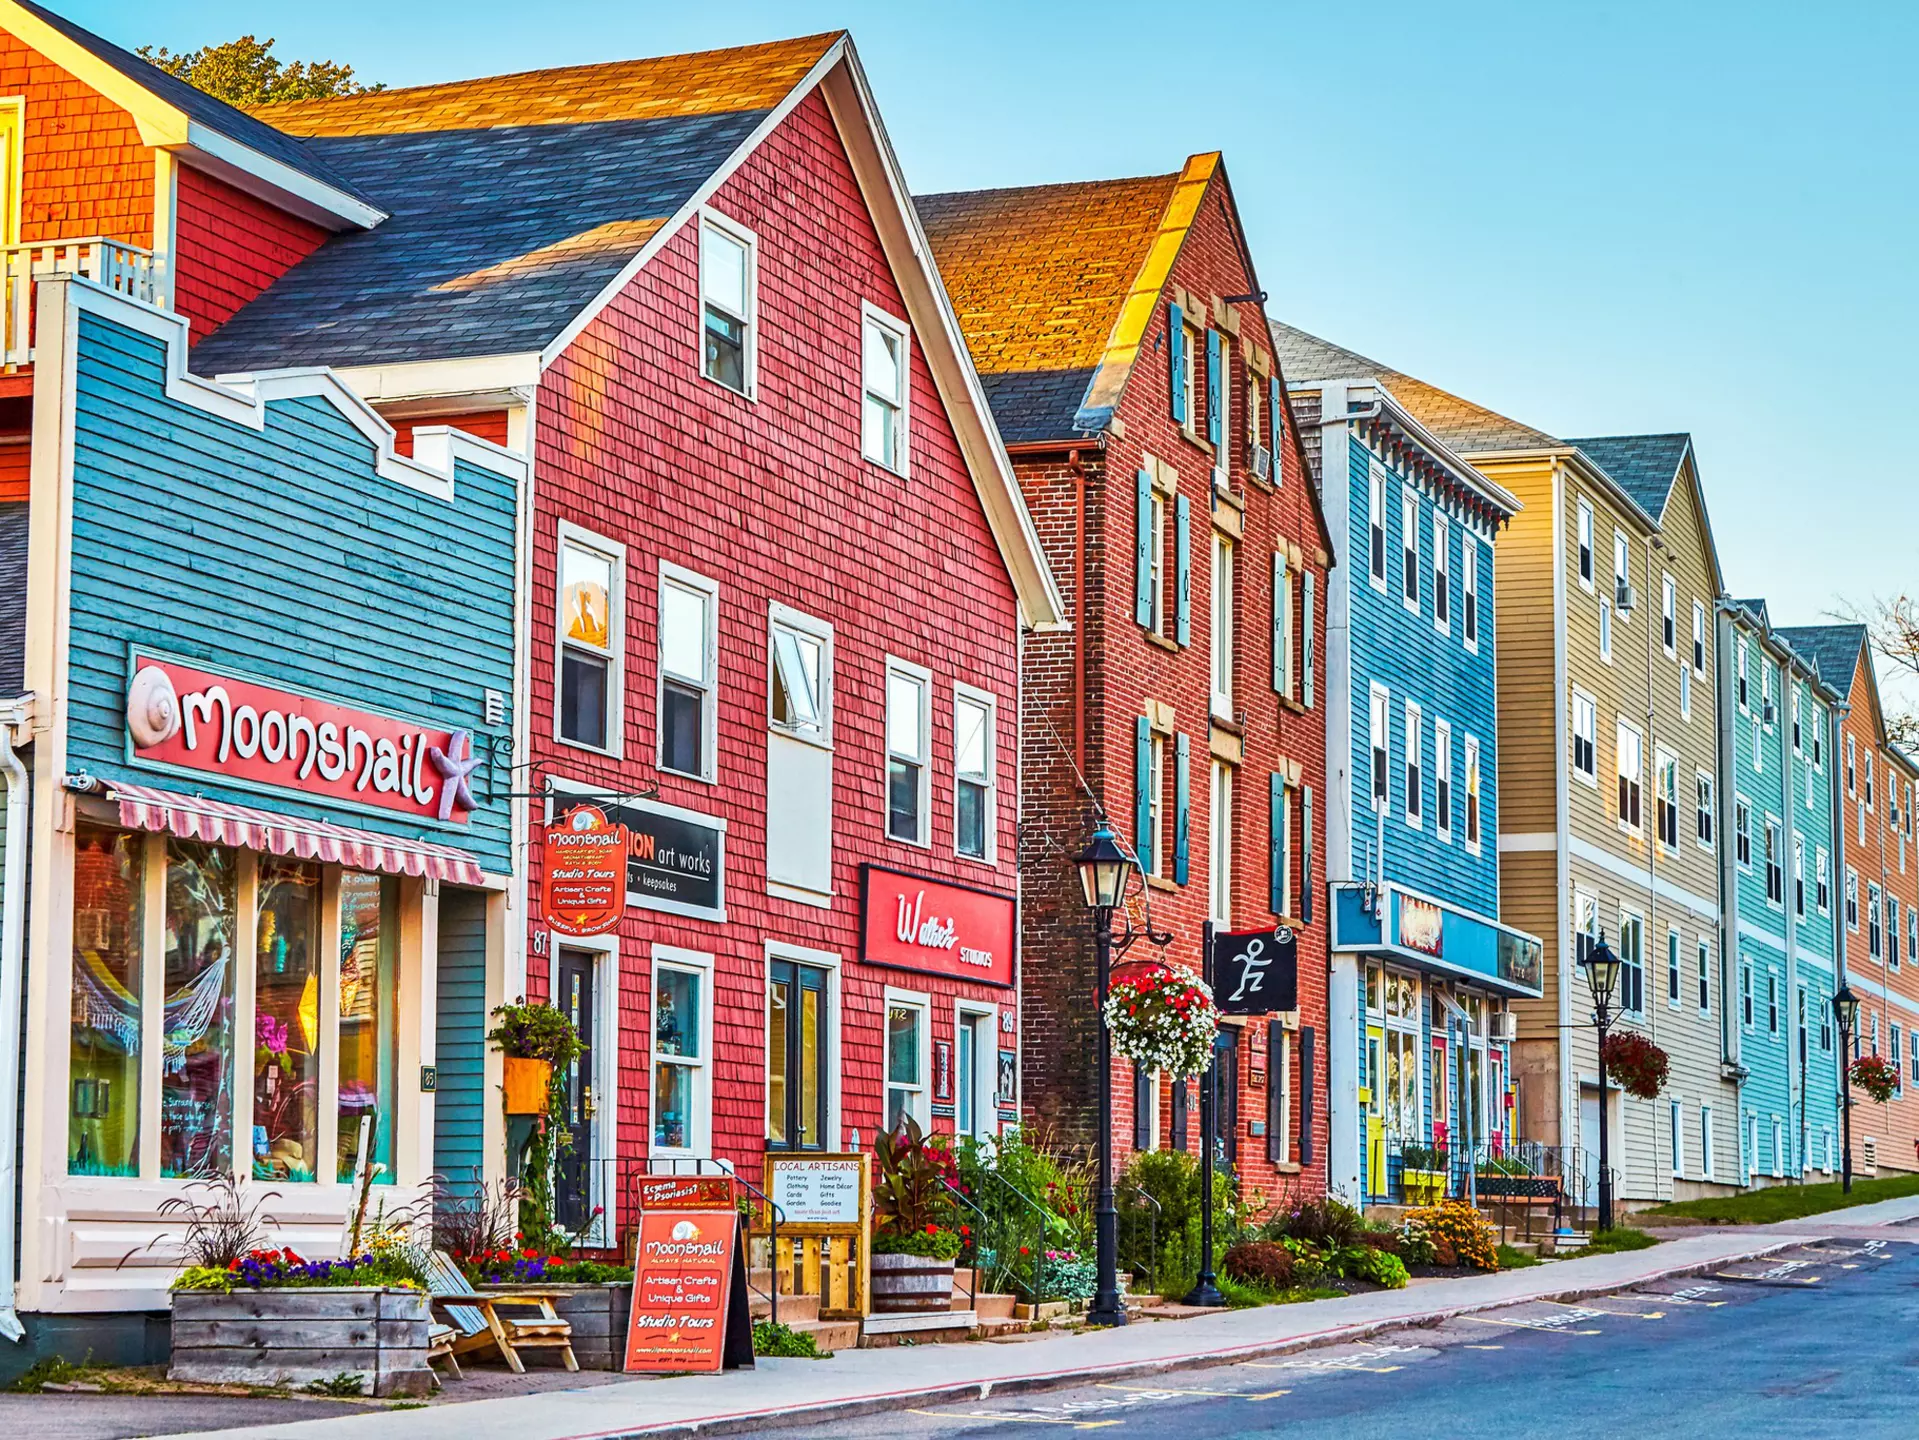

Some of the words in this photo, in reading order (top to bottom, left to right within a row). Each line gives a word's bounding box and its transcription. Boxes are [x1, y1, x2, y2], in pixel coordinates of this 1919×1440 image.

[182, 685, 434, 805] Moonsnail
[548, 830, 621, 847] Moonsnail
[658, 847, 675, 866] art
[679, 850, 711, 874] works
[552, 868, 584, 879] Studio
[586, 869, 616, 879] Tours
[643, 873, 677, 892] keepsakes
[557, 898, 586, 906] Unique
[534, 929, 547, 955] 87
[960, 946, 993, 968] STUDIOS
[1002, 1010, 1014, 1032] 89
[774, 1162, 805, 1171] LOCAL
[808, 1162, 860, 1171] ARTISANS
[786, 1174, 808, 1182] Pottery
[820, 1174, 842, 1182] Jewelry
[654, 1183, 698, 1202] Psoriasis?
[786, 1183, 809, 1191] Clothing
[646, 1240, 725, 1257] Moonsnail
[645, 1276, 683, 1285] Artisan
[684, 1276, 718, 1285] Crafts
[676, 1285, 684, 1294] &
[648, 1293, 683, 1305] Unique
[685, 1294, 711, 1303] Gifts
[637, 1314, 677, 1328] Studio
[679, 1315, 715, 1328] Tours
